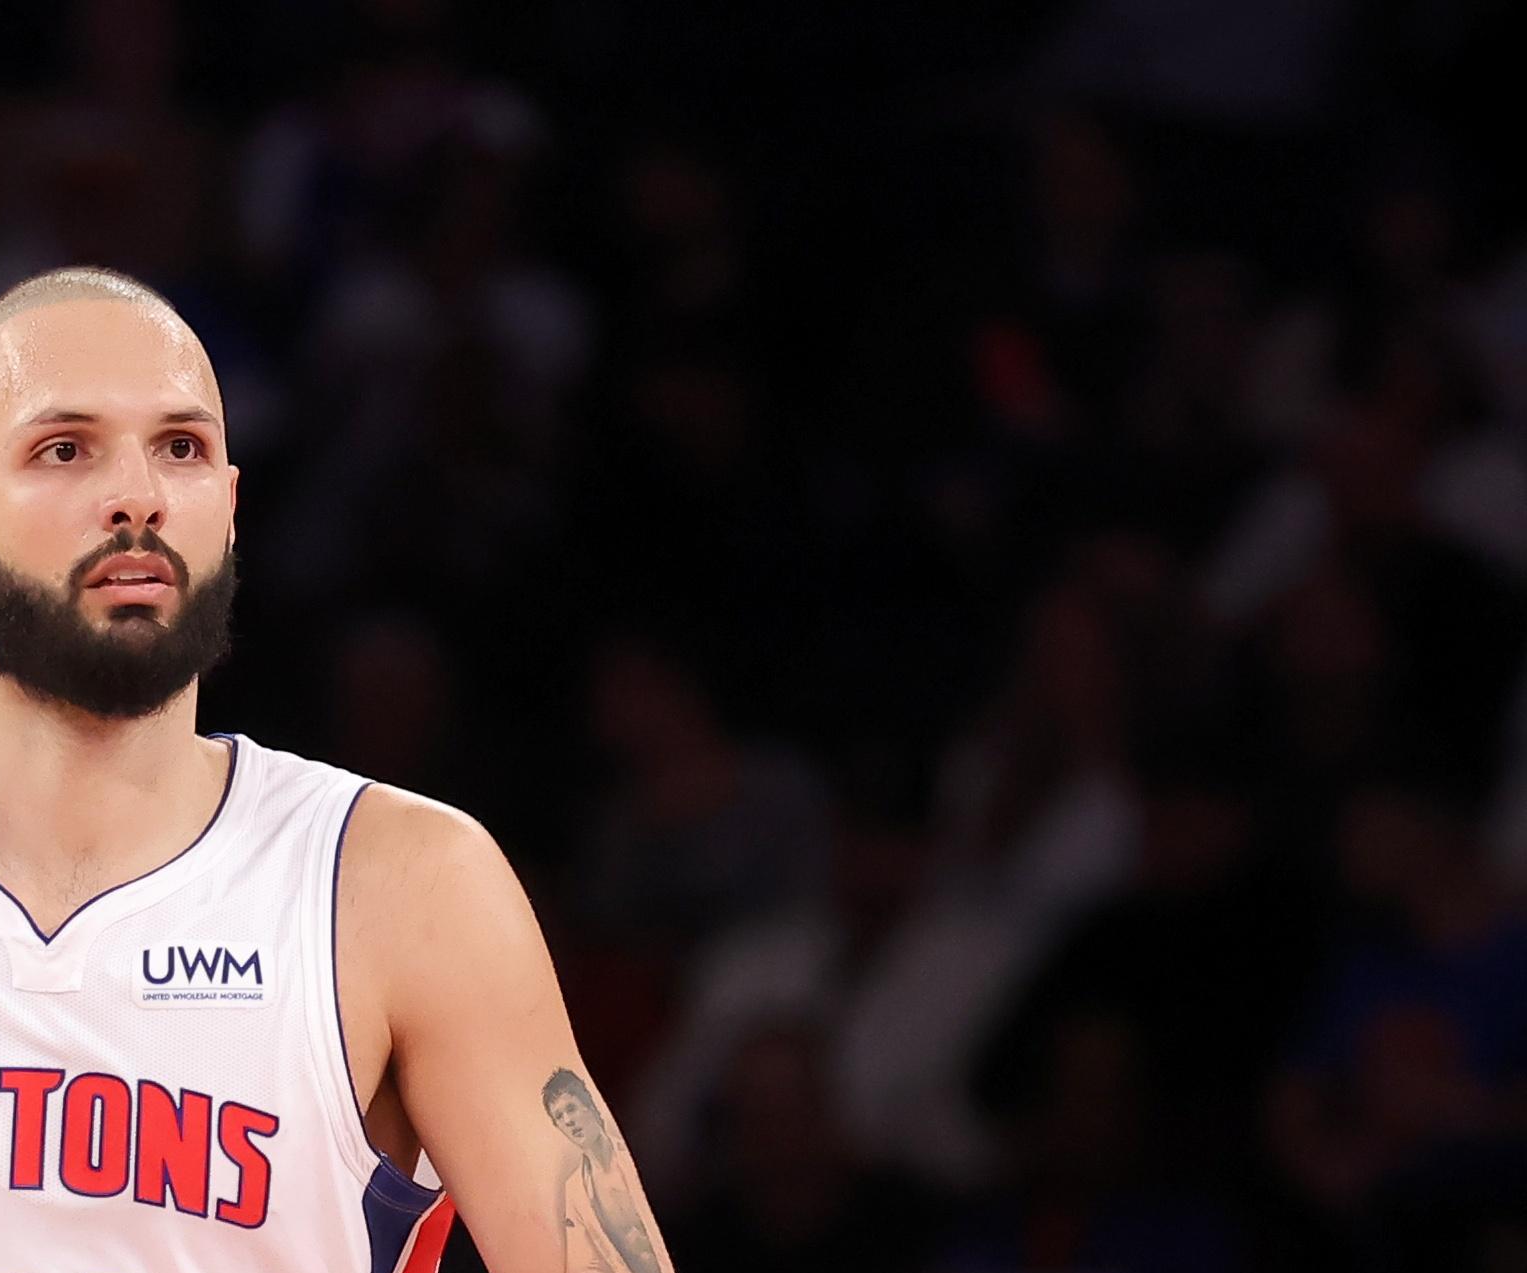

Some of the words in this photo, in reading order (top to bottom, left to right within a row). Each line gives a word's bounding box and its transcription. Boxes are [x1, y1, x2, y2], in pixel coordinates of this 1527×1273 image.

[143, 946, 263, 985] UWM
[142, 992, 171, 1001] UNITED
[172, 992, 217, 1001] WHOLESALE
[219, 992, 264, 1001] MORTGAGE
